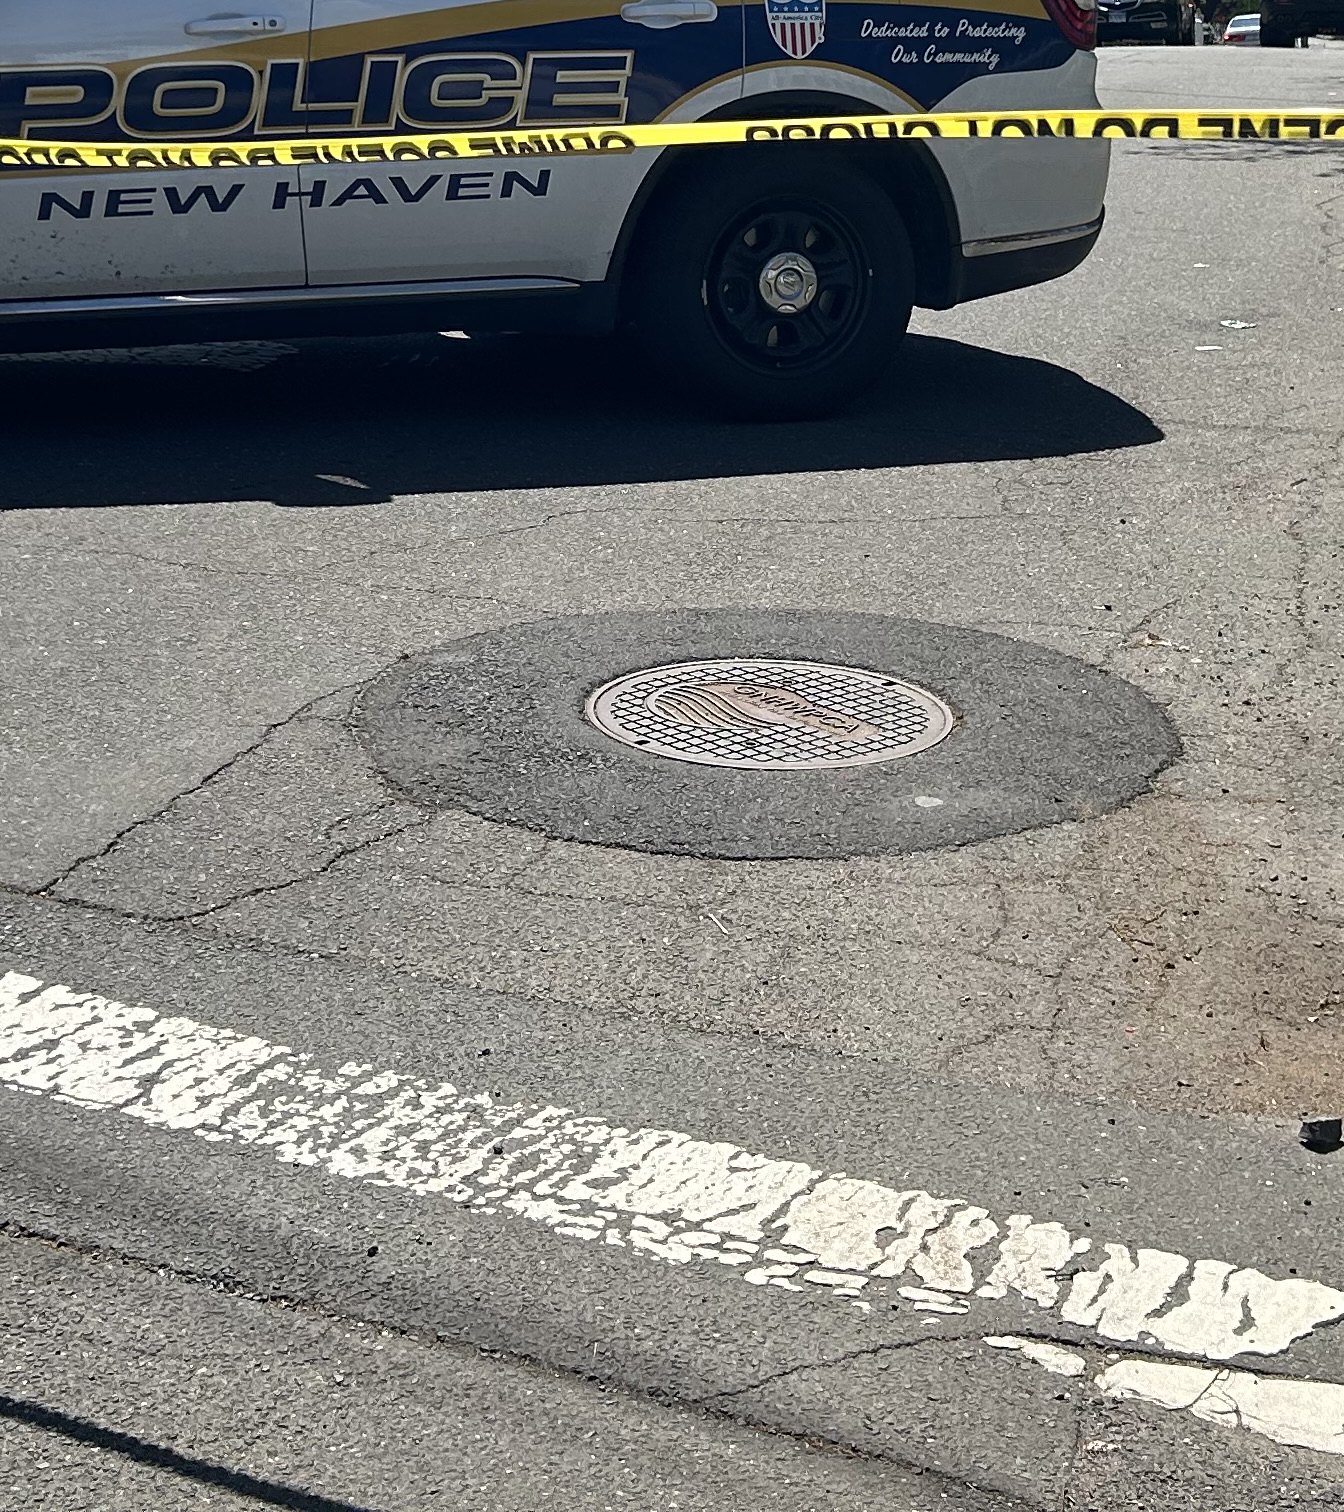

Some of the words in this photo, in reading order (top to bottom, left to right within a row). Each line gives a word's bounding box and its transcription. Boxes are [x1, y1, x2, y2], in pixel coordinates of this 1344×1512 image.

[860, 18, 930, 38] Dedicated
[934, 21, 950, 38] to
[956, 18, 1027, 45] Protecting
[891, 44, 919, 64] Our
[923, 44, 1001, 71] Community
[37, 183, 246, 221] NEW
[271, 169, 552, 211] HAVEN
